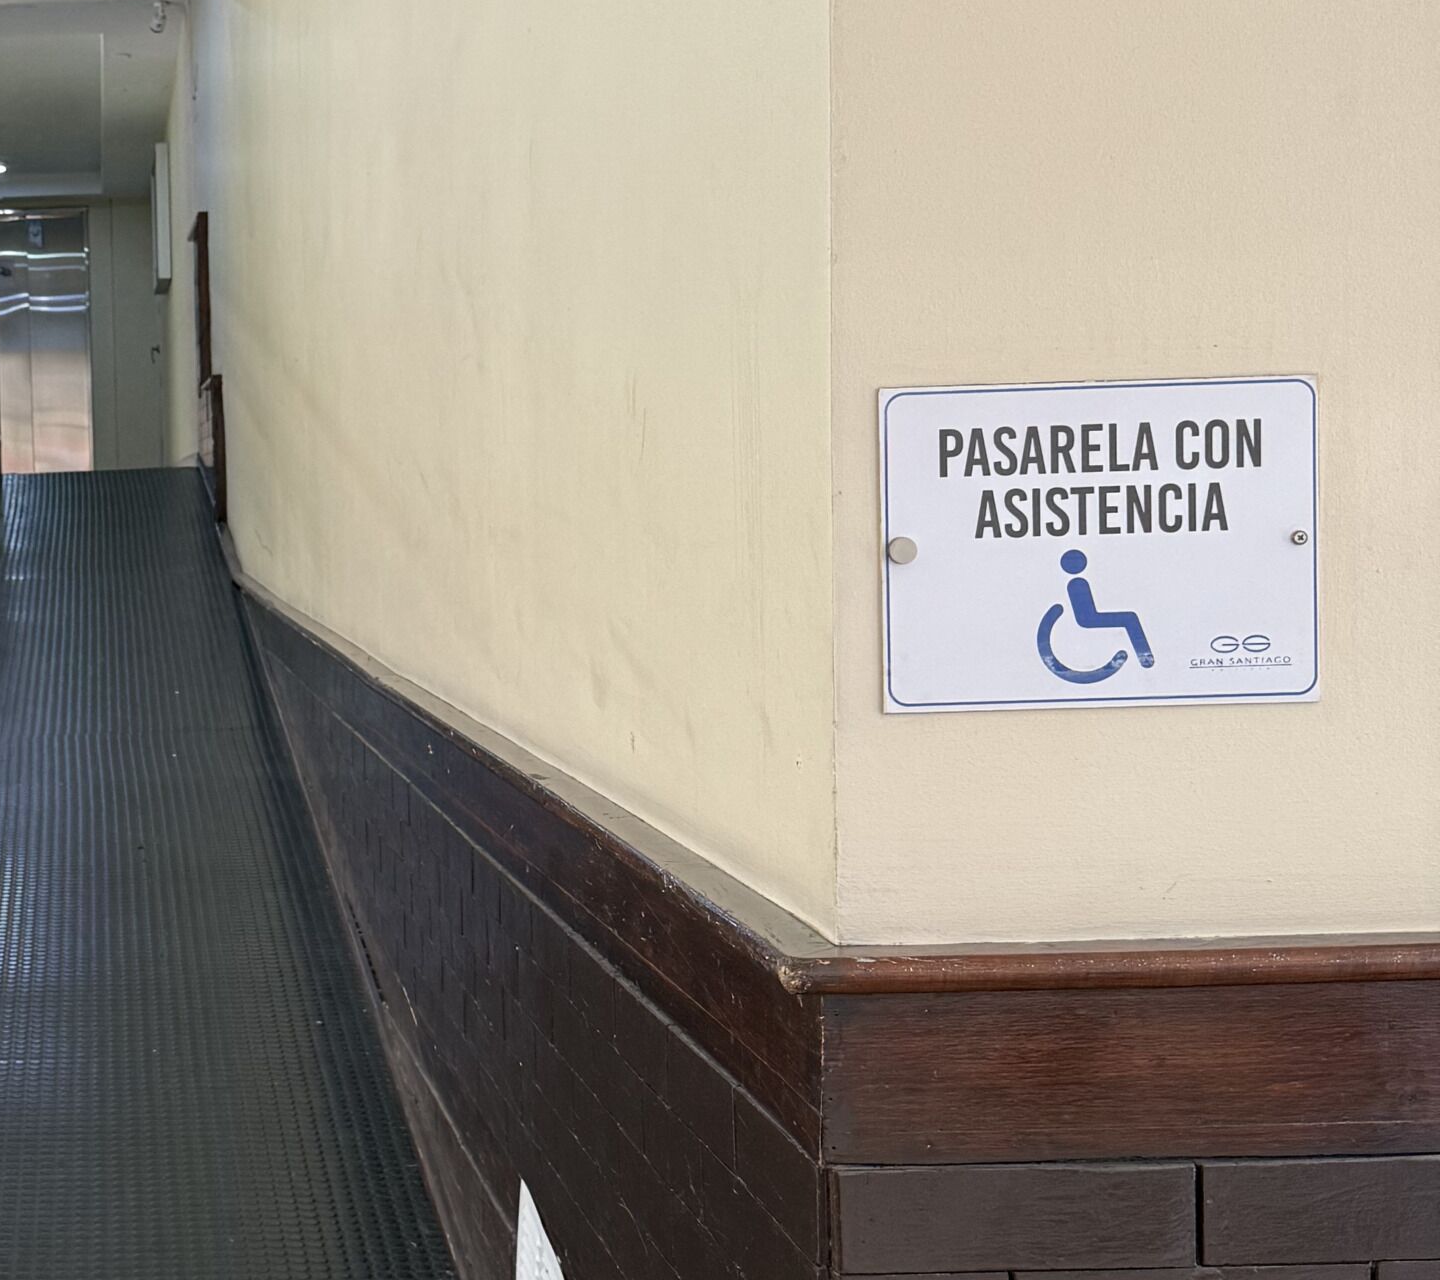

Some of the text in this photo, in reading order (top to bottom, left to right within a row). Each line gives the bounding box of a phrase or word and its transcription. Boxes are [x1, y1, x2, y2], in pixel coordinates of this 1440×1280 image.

[938, 418, 1262, 478] PASARELA CON
[974, 482, 1229, 539] ASISTENCIA
[1190, 656, 1292, 667] GRAN SANTIAGO
